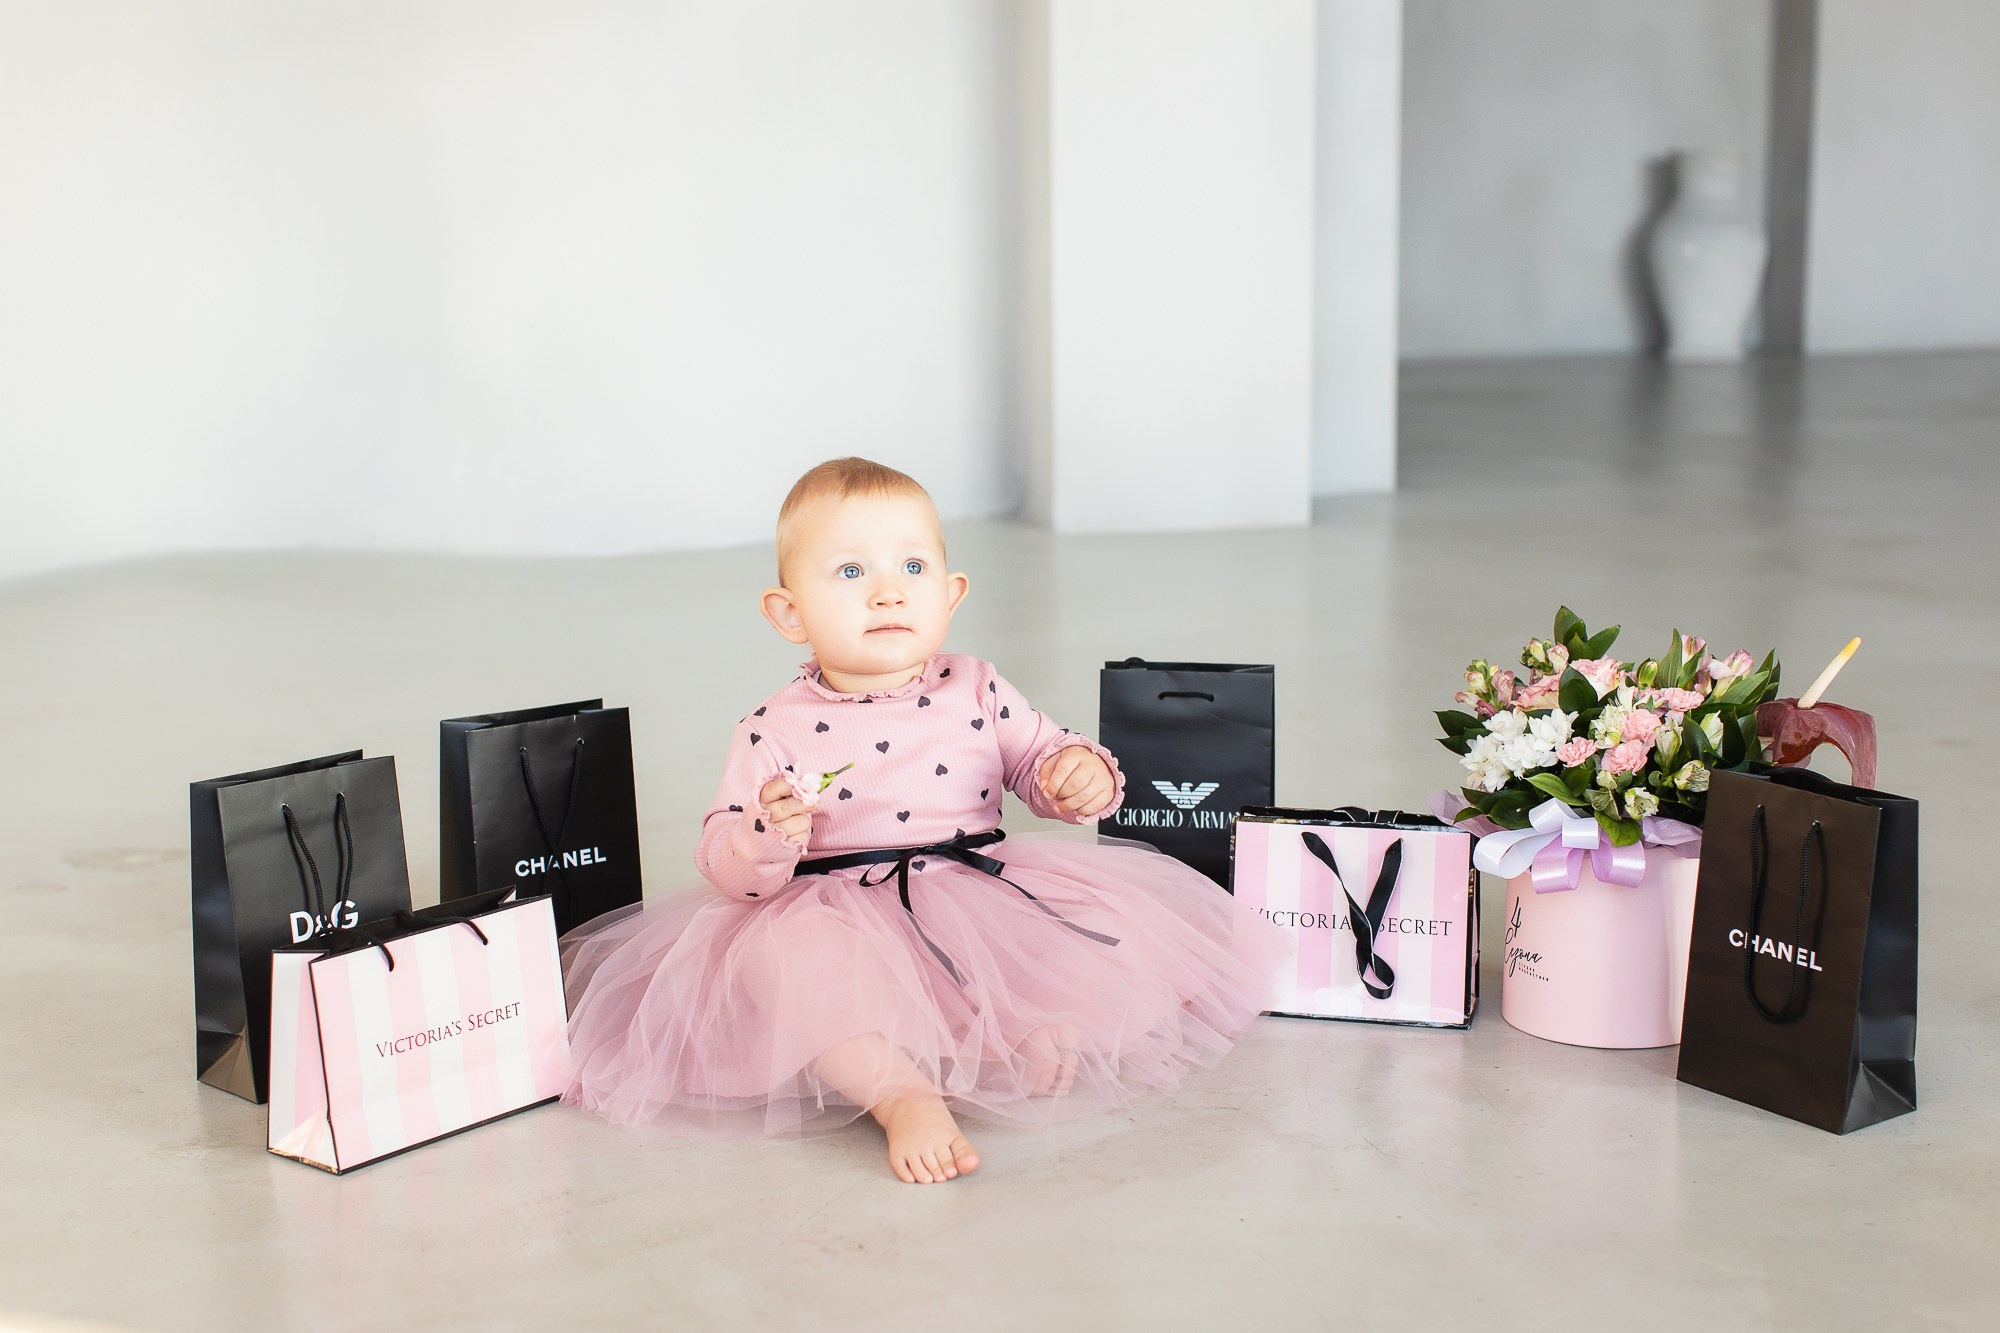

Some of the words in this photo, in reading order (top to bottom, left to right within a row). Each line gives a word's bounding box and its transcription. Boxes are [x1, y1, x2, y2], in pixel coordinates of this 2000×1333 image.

[1115, 808, 1184, 828] GIORGIO
[1188, 810, 1240, 830] ARMA
[515, 846, 607, 877] CHANEL
[289, 900, 359, 944] D&G
[1510, 896, 1522, 938] 4
[1728, 928, 1823, 972] CHANEL
[375, 1020, 463, 1058] VICTORIA'S
